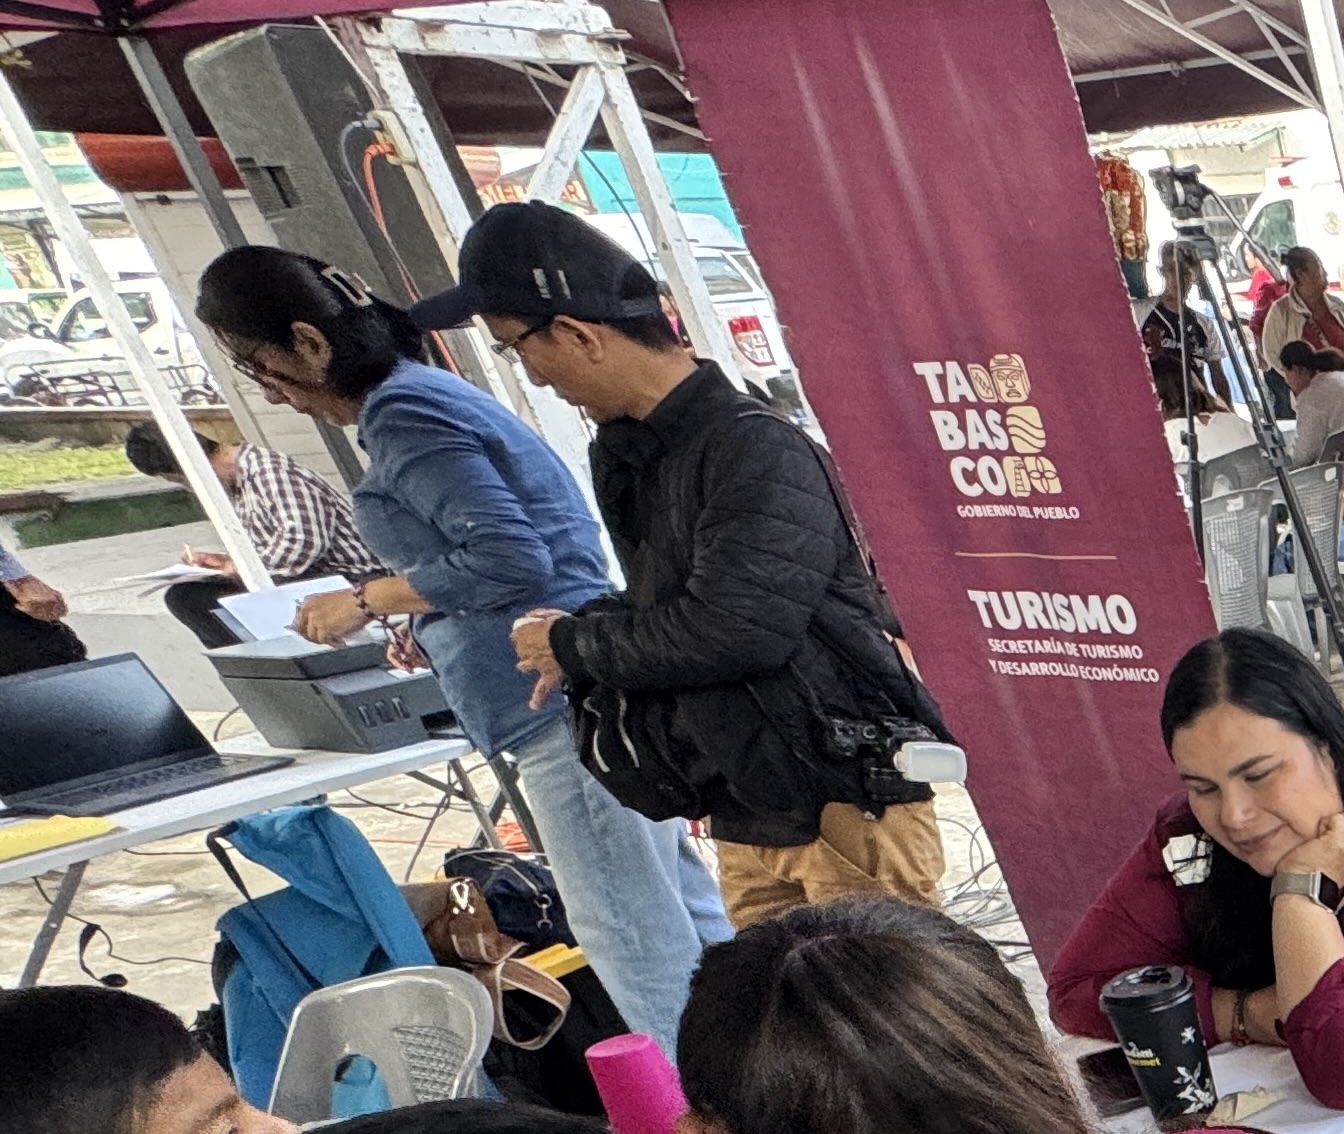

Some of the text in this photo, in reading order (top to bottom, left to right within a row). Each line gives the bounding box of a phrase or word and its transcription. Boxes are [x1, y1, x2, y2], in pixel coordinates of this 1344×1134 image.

[956, 504, 1080, 519] GOBIERNO DEL PUEBLO
[967, 589, 1137, 635] TURISMO
[987, 637, 1143, 660] SECRETARÍA DE TURISMO
[988, 658, 1160, 683] Y DESARROLLO ECONÓMICO
